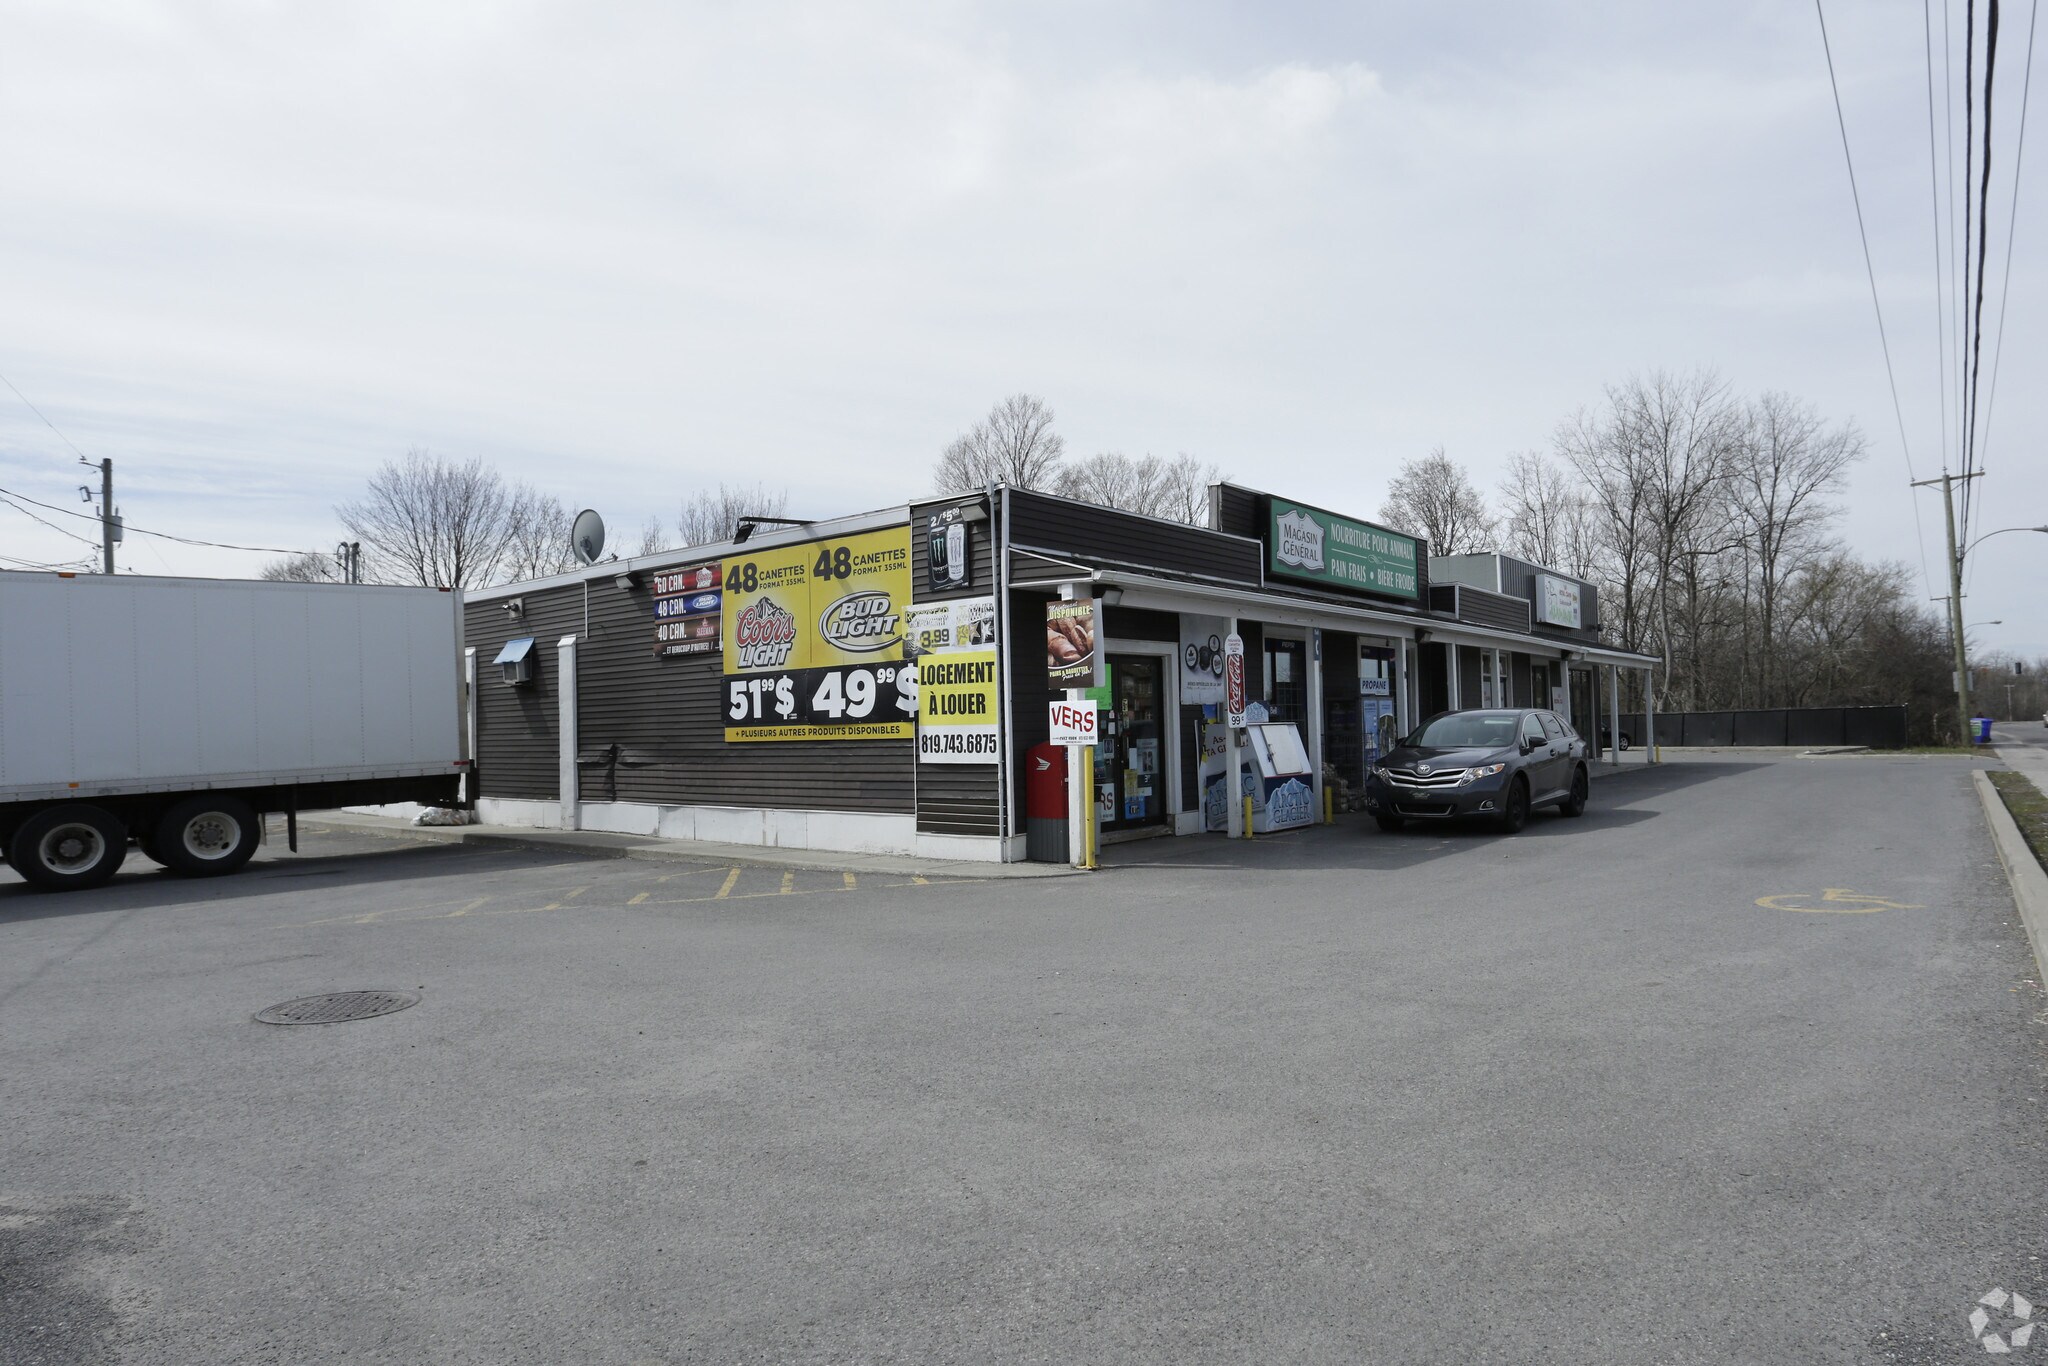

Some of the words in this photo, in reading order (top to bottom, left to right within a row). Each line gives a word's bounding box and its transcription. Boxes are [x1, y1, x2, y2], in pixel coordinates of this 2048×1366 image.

[1283, 540, 1318, 562] GÉNÉRAL
[1331, 523, 1370, 550] NOURRITURE
[1372, 535, 1389, 555] POUR
[1390, 540, 1414, 561] ANIMAUX
[813, 546, 851, 581] 48
[853, 548, 906, 566] CANETTES
[725, 562, 758, 594] 48
[759, 565, 805, 581] CANETTES
[853, 565, 882, 576] FORMAT
[884, 562, 907, 572] 355ML
[1331, 558, 1346, 578] PAIN
[1349, 563, 1366, 583] FRAIS
[1377, 565, 1393, 587] BIÈRE
[1395, 571, 1415, 592] FROIDE
[657, 577, 666, 593] 60
[668, 573, 685, 591] CAN.
[759, 581, 784, 590] FORMAT
[786, 577, 805, 586] 355ML
[658, 600, 667, 617] 48
[669, 597, 686, 615] CAN.
[839, 598, 890, 620] BUD
[1049, 605, 1090, 620] DISPONIBLE
[657, 624, 667, 641] 40
[669, 622, 686, 640] CAN.
[736, 606, 796, 648] Coors
[829, 615, 900, 639] LIGHT
[738, 641, 792, 669] LIGHT
[920, 661, 995, 686] LOGEMENT
[1228, 653, 1243, 714] Coca-Cola
[1362, 680, 1386, 690] PROPANE
[929, 690, 938, 715] À
[941, 693, 986, 715] LOUER
[1051, 705, 1094, 733] VERS
[741, 729, 777, 738] PLUSIEURS
[779, 727, 806, 737] AUTRES
[808, 726, 846, 736] PRODUITS
[848, 725, 900, 735] DISPONIBLES
[921, 734, 997, 754] 819.743.6875
[1274, 787, 1310, 809] ARCTIC
[1273, 806, 1309, 823] GLACIER
